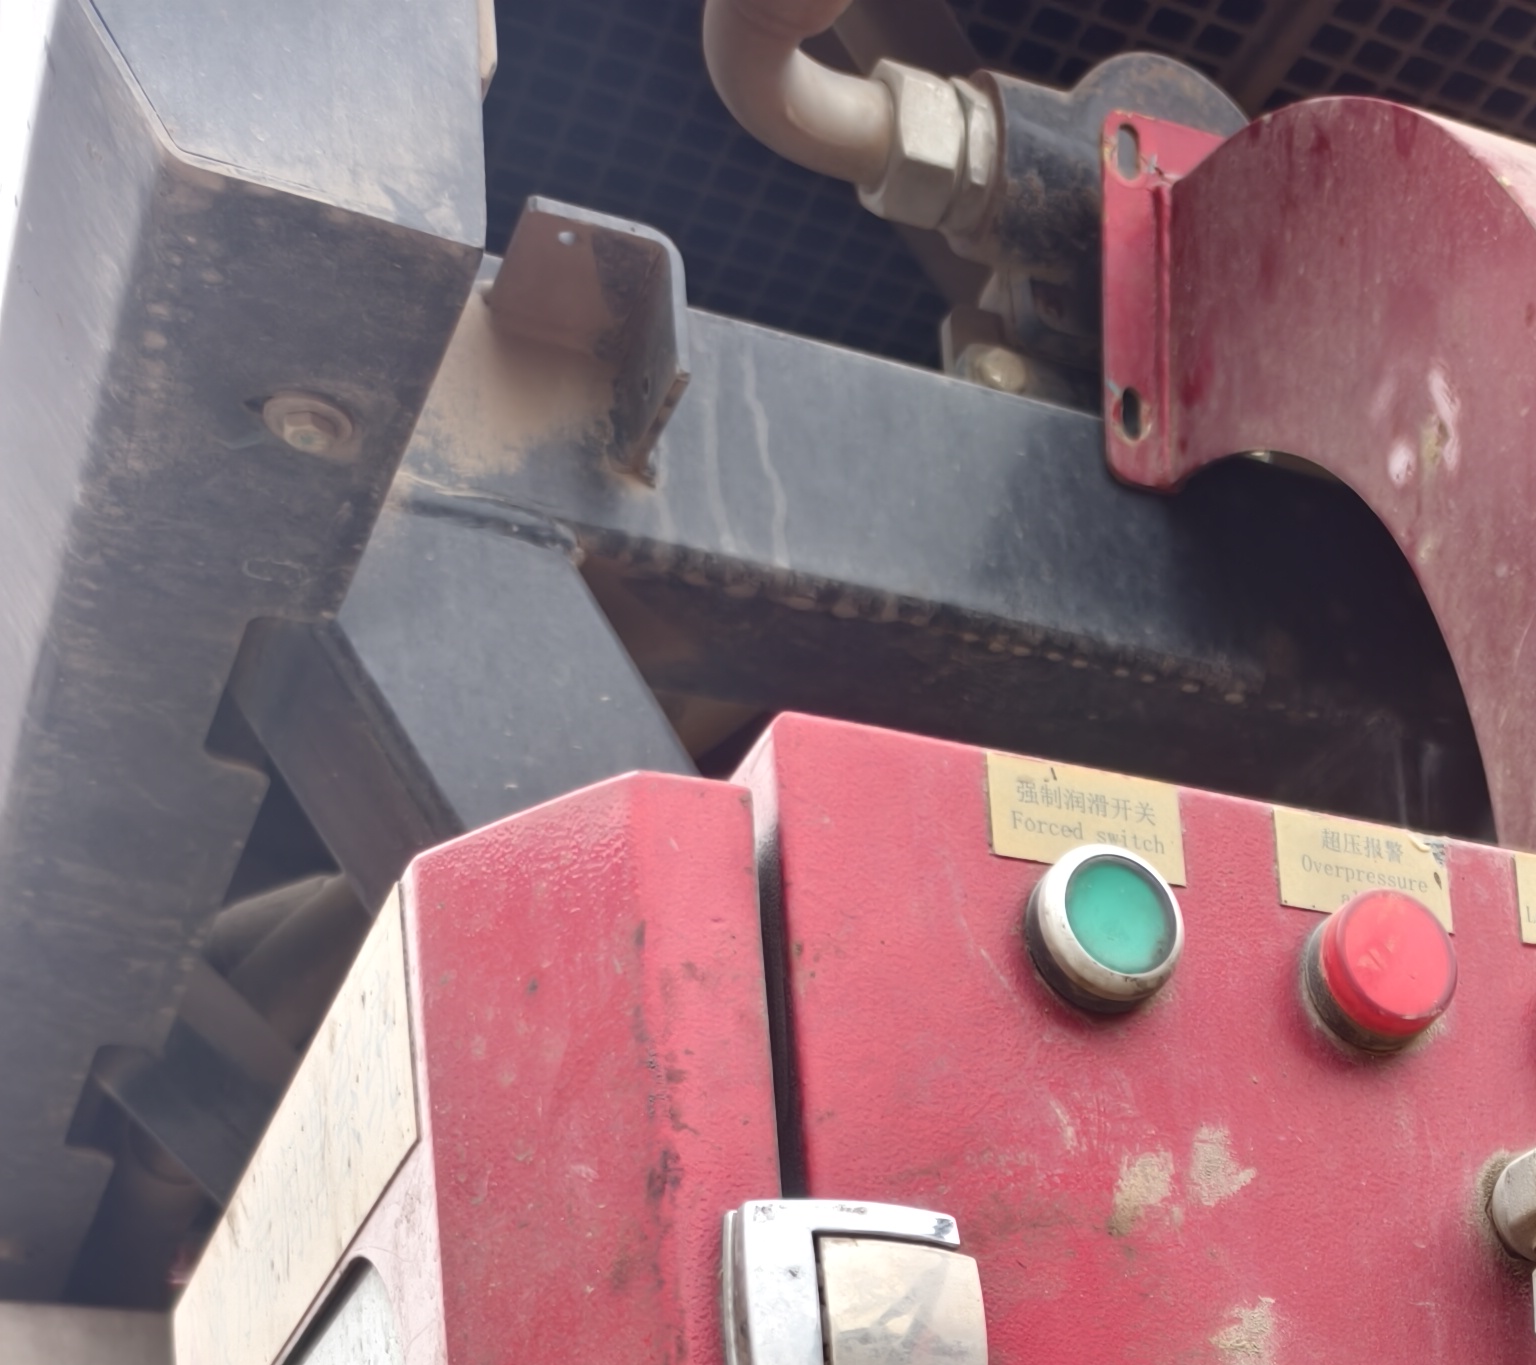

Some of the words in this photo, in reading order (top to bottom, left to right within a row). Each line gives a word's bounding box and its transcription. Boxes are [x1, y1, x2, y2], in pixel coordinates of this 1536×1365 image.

[1016, 779, 1156, 826] 强制润滑开关
[1011, 810, 1084, 840] Forced
[1097, 829, 1165, 855] switch
[1321, 828, 1404, 864] 超压报警
[1301, 854, 1428, 893] Overpressure
